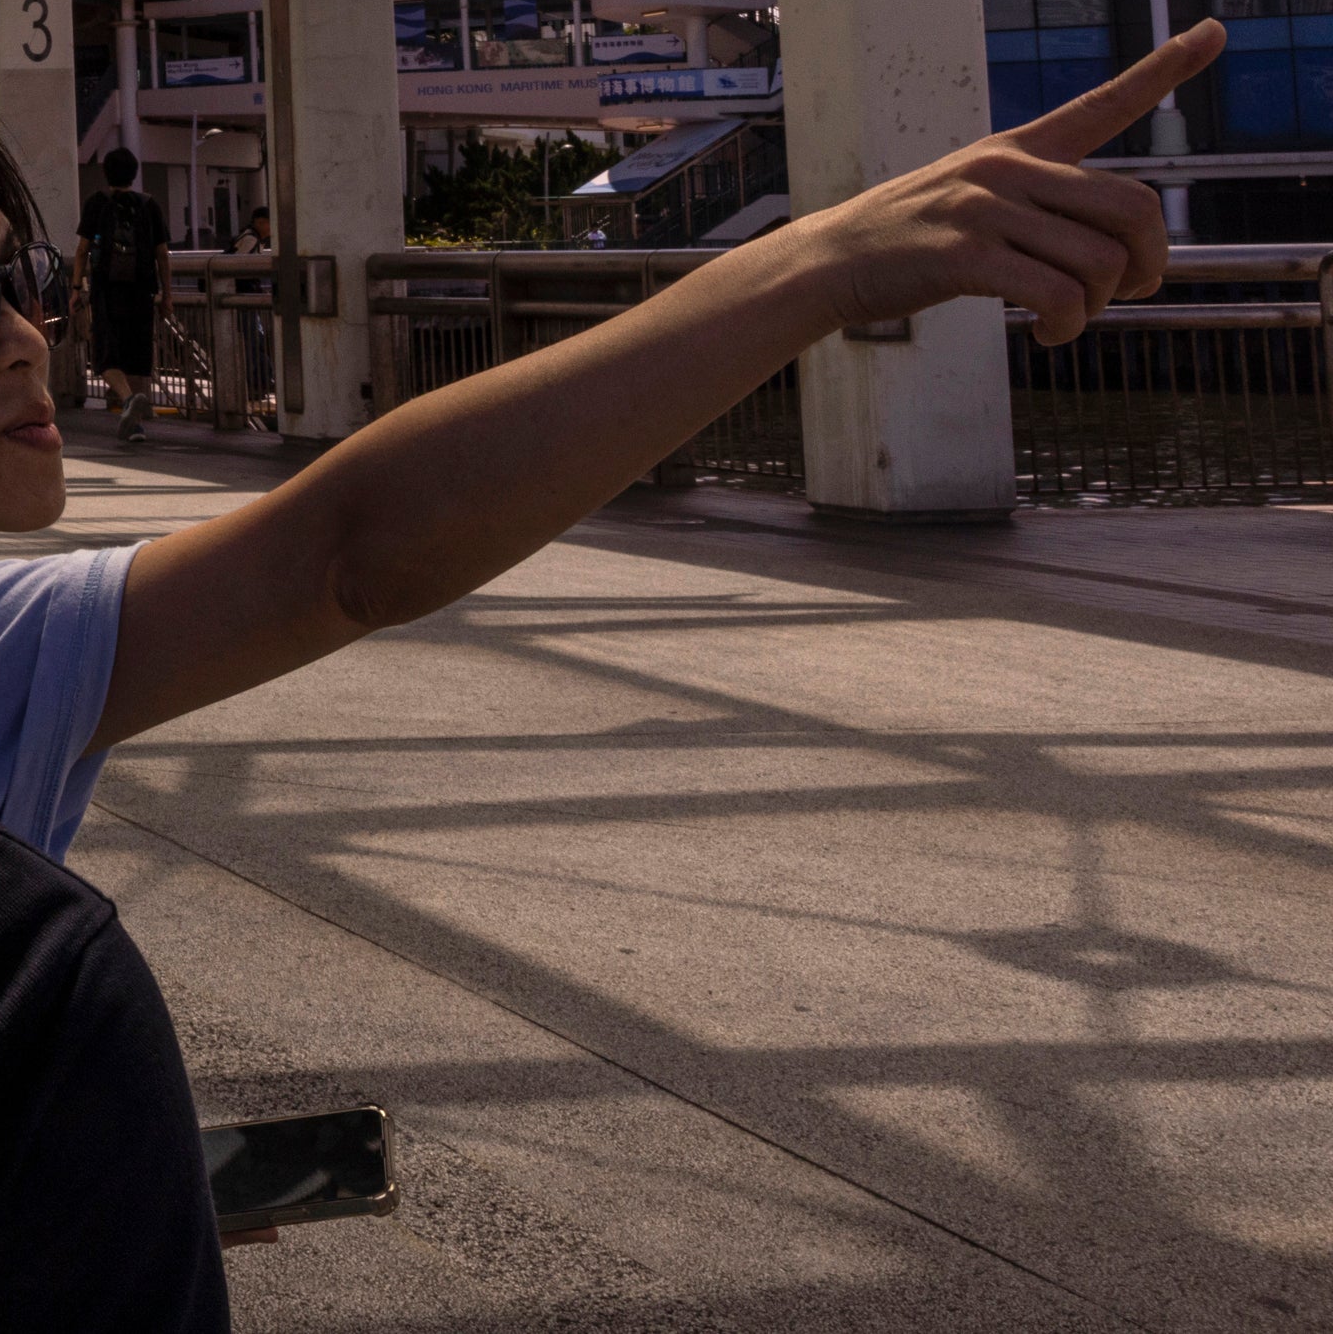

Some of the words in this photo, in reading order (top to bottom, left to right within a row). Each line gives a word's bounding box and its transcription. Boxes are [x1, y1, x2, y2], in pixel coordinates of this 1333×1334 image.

[417, 85, 453, 96] HONG
[457, 83, 493, 94] KONG
[501, 80, 564, 92] MARITIME
[568, 78, 598, 89] MUS
